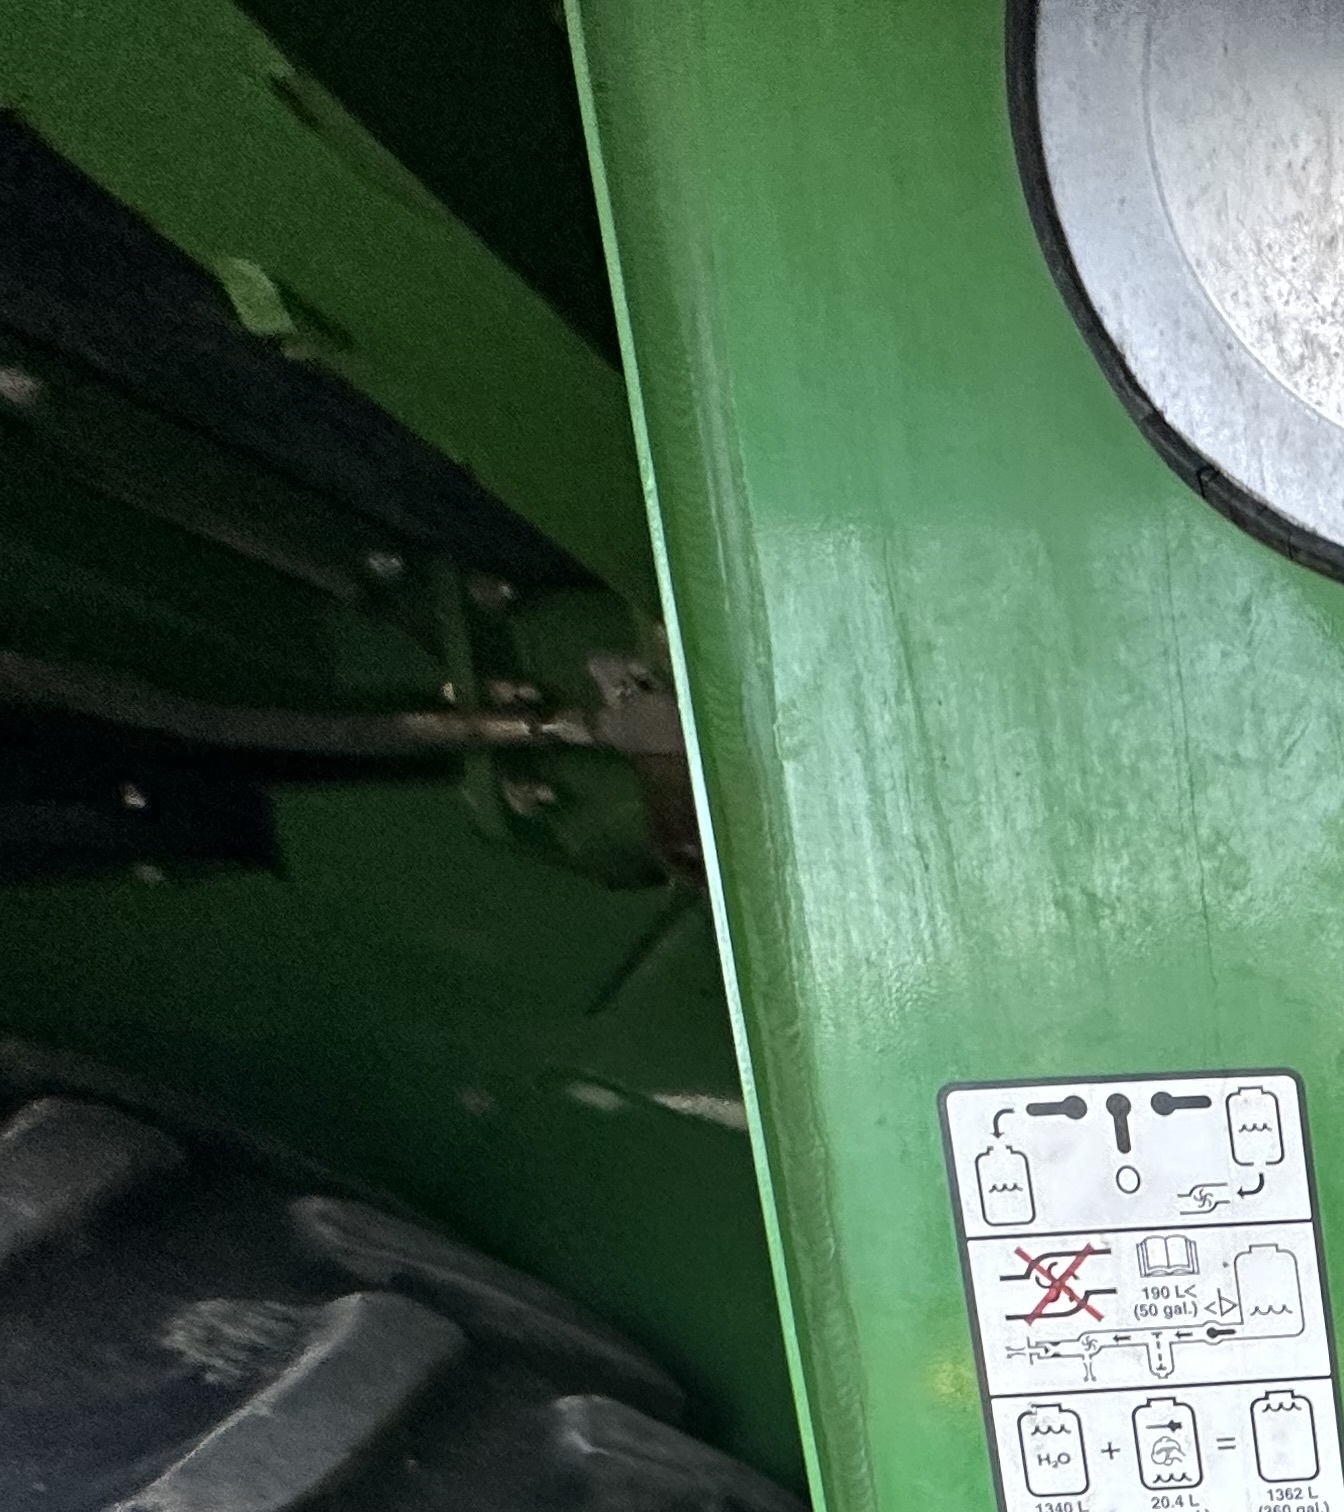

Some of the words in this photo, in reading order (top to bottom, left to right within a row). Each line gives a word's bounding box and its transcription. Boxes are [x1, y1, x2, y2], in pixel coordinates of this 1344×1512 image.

[1142, 1285, 1171, 1301] 190
[1133, 1303, 1159, 1321] (50
[1162, 1300, 1198, 1319] gal.)
[1150, 1494, 1184, 1510] 20.4
[1188, 1493, 1200, 1508] L
[1267, 1487, 1303, 1502] 1362
[1307, 1486, 1319, 1500] L
